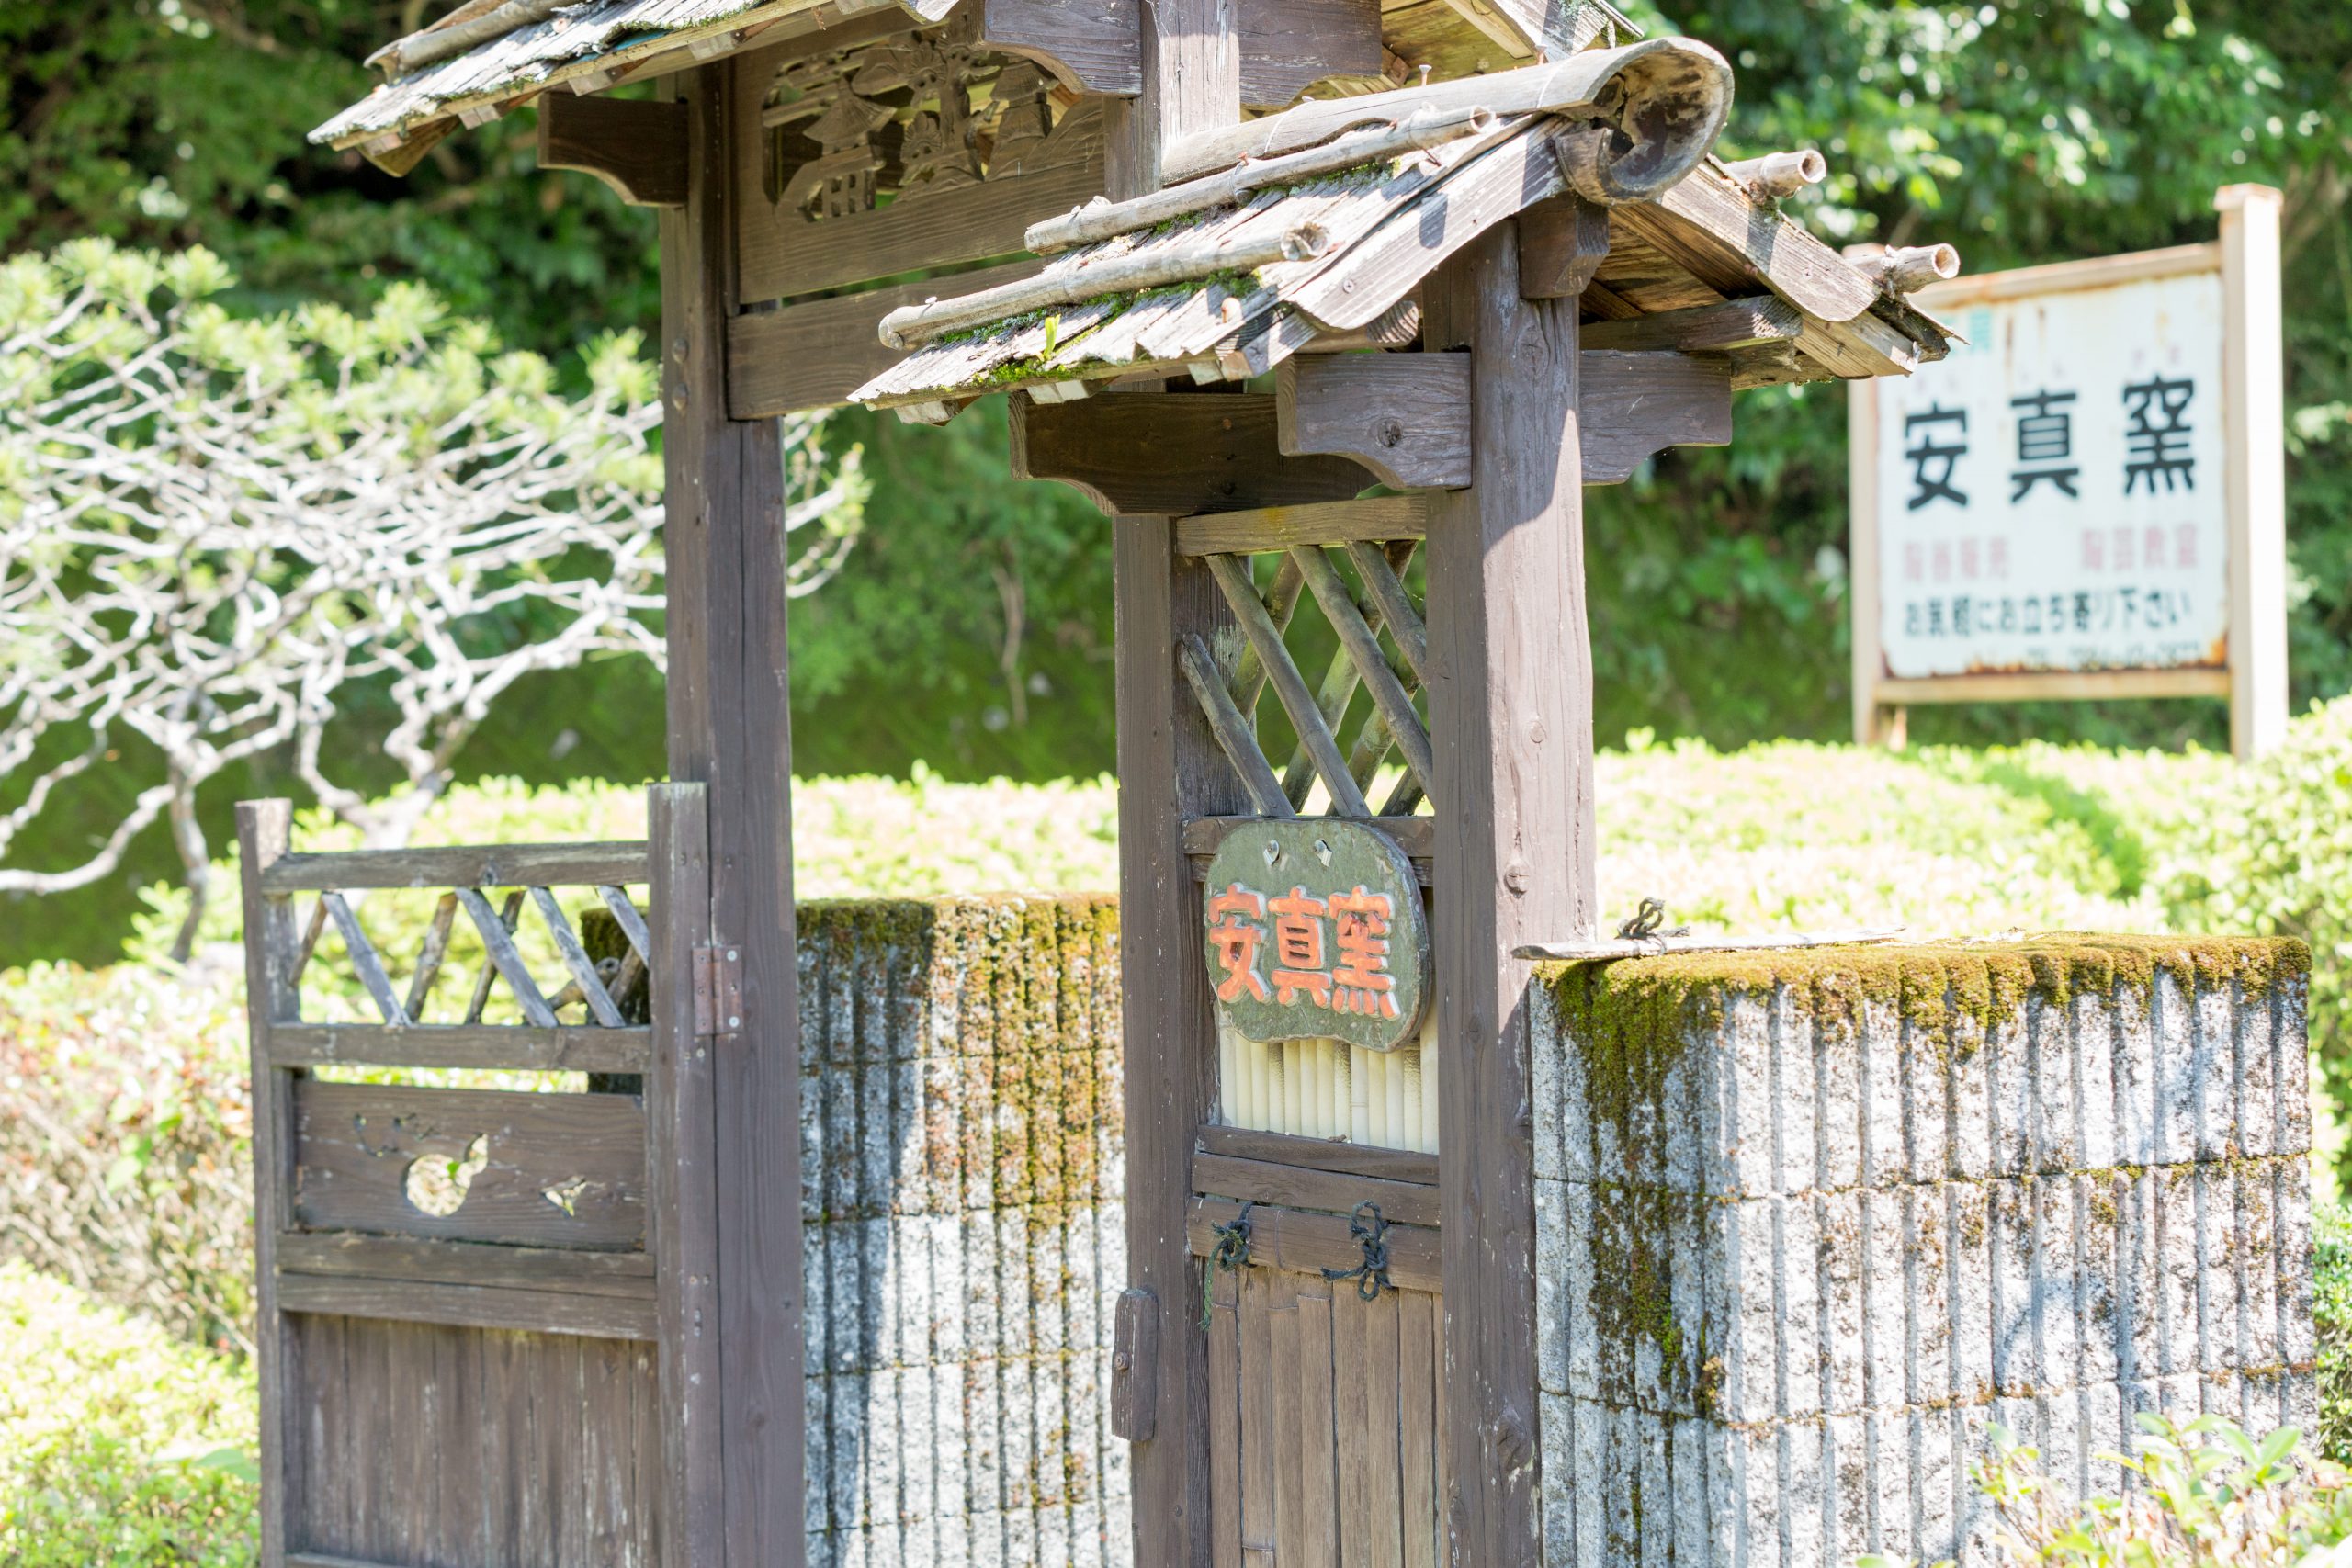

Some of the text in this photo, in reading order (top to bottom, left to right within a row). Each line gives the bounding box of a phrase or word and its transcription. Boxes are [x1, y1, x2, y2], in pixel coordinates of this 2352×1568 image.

[1905, 373, 2196, 511] 安真窯
[1208, 882, 1401, 1021] 安真窯
